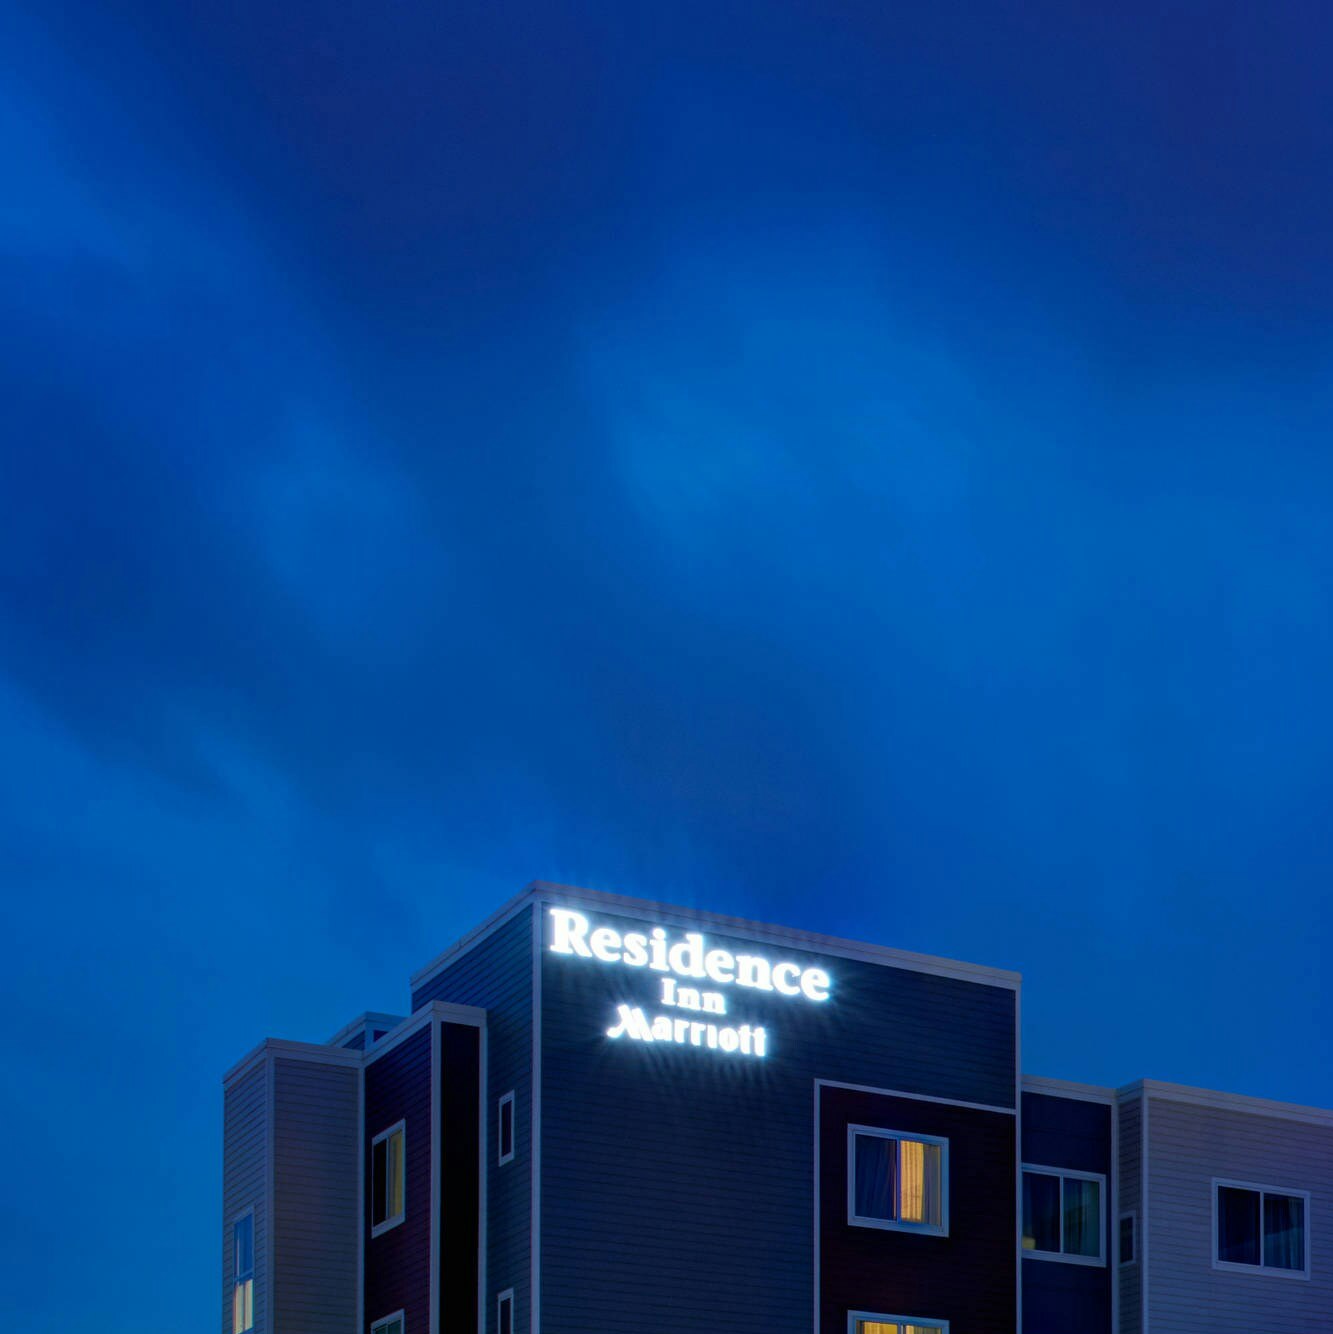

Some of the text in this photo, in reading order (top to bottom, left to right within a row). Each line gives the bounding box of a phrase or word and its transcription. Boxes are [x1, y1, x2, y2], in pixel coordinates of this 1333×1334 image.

[549, 908, 831, 1001] Residence
[660, 977, 727, 1015] Inn
[606, 1003, 768, 1057] Marriott
